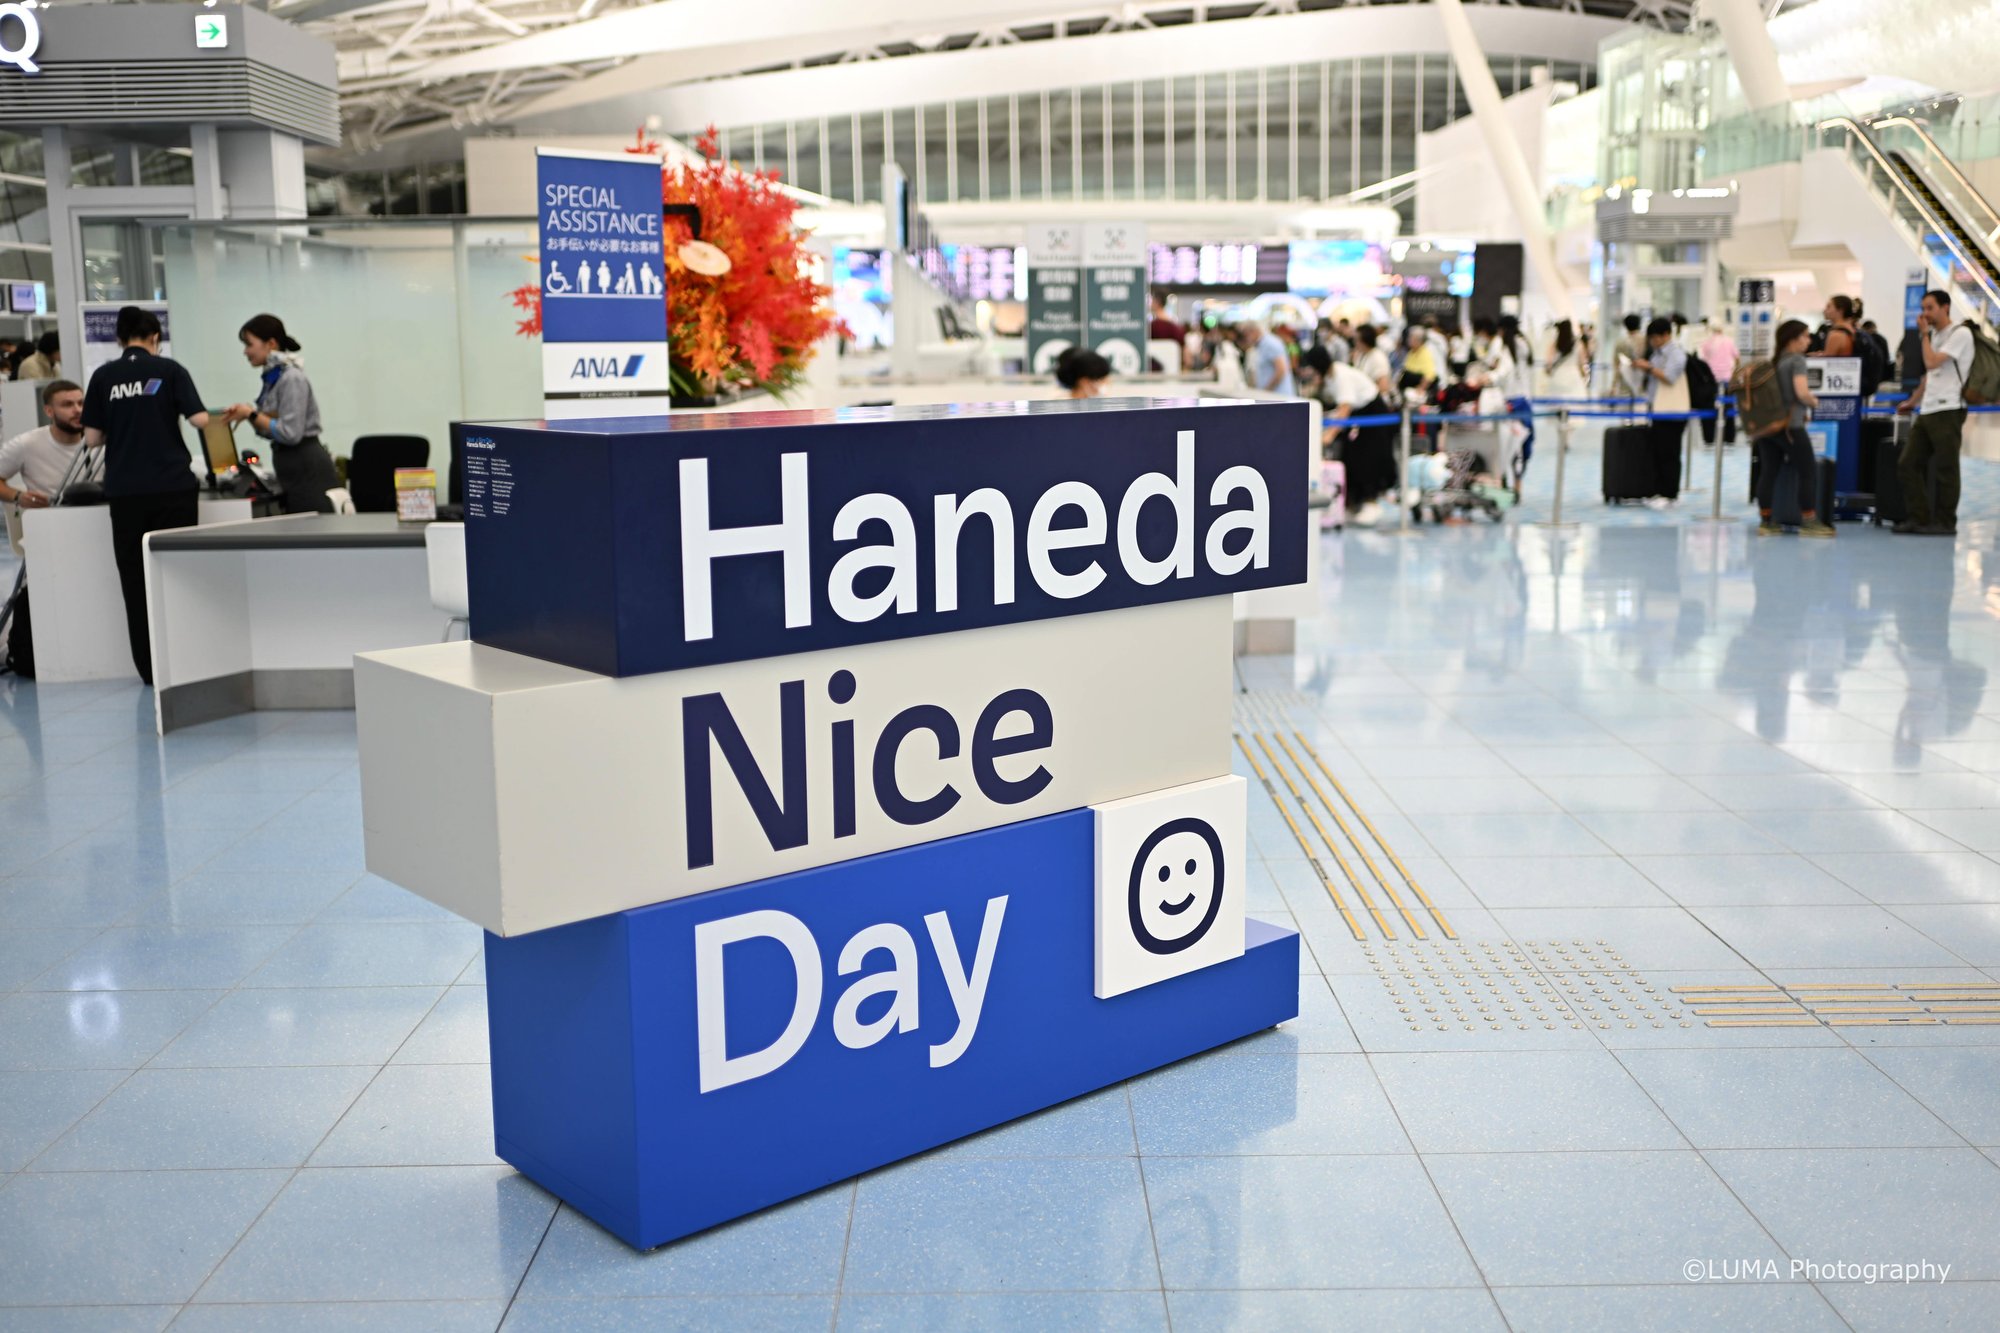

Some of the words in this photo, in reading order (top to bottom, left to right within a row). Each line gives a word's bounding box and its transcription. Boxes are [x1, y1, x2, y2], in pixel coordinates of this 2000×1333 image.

[0, 2, 40, 73] Q
[545, 184, 621, 209] SPECIAL
[546, 209, 658, 236] ASSISTANCE
[109, 381, 143, 401] ANA
[571, 357, 618, 379] ANA
[679, 430, 1271, 641] Haneda
[682, 670, 1054, 871] Nice
[695, 895, 1009, 1094] Day
